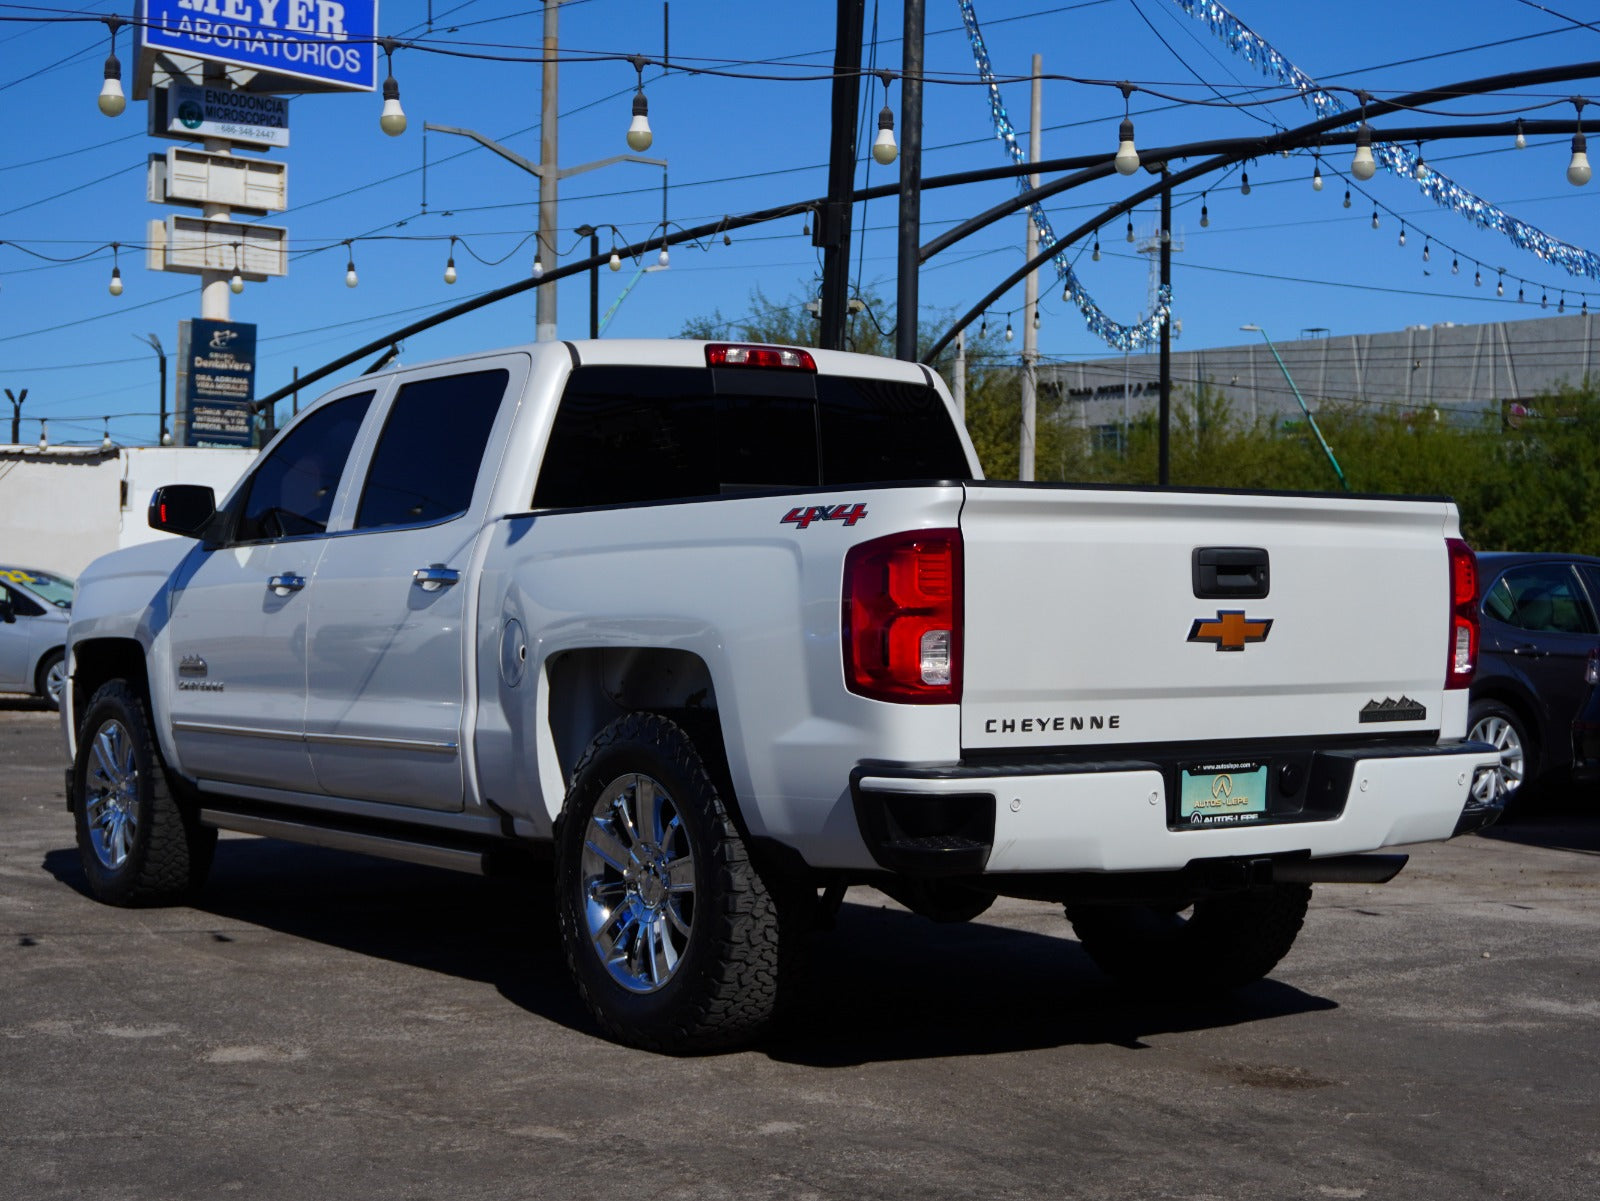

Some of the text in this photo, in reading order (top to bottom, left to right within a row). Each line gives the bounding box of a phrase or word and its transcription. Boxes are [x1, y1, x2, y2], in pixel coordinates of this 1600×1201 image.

[162, 11, 361, 73] LABORATORIOS
[205, 89, 285, 114] ENDODONCIA
[205, 105, 284, 128] MICROSCOPICA
[985, 715, 1120, 733] CHEYENNE
